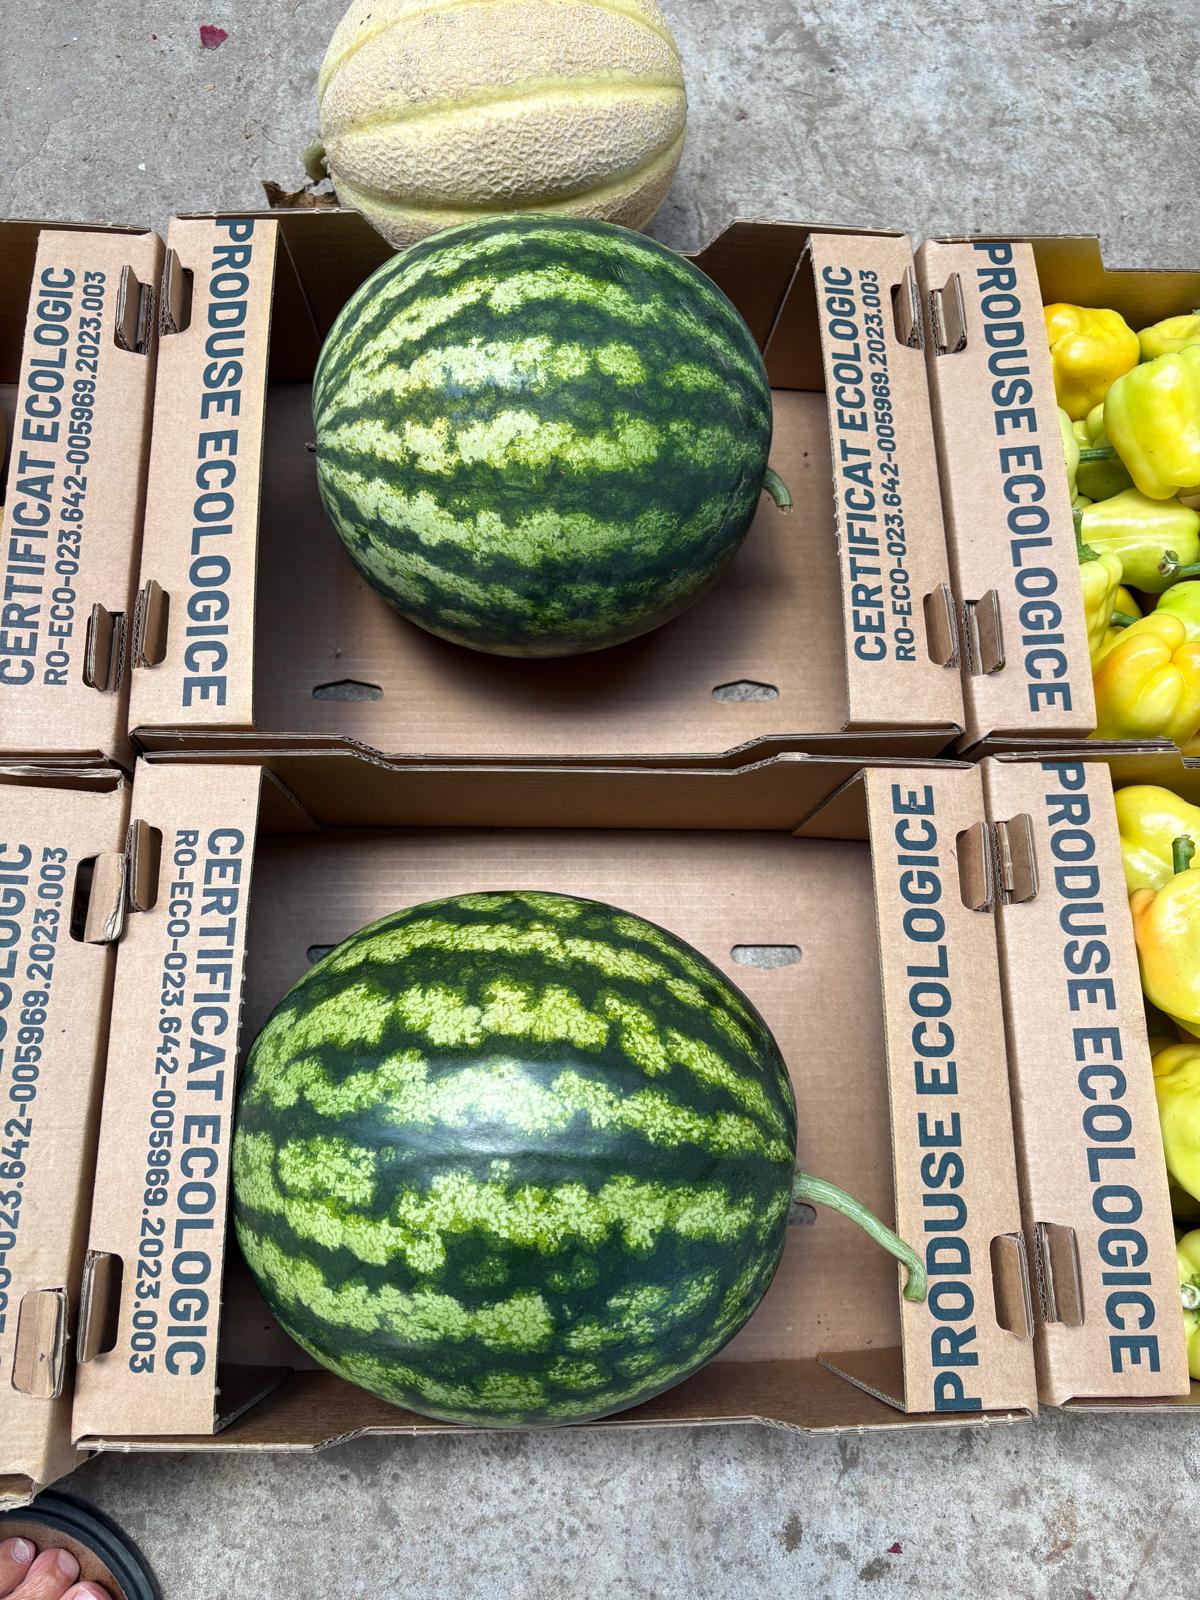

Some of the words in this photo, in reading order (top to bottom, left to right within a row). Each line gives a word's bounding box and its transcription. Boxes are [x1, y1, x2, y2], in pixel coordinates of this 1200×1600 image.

[22, 267, 76, 443] ECOLOGIC
[200, 218, 255, 420] PRODUSE
[822, 266, 868, 432] ECOLOGIC
[973, 242, 1037, 436] PRODUSE
[0, 450, 56, 686] CERTIFICAT
[43, 271, 106, 685] RO-ECO-023.642-005969.2023.003
[182, 429, 239, 707] ECOLOGICE
[840, 439, 887, 661] CERTIFICAT
[859, 270, 915, 661] RO-ECO-023.642-005969.2023.003
[1000, 445, 1072, 712] ECOLOGICE
[186, 828, 245, 1101] CERTIFICAT
[891, 783, 958, 1095] ECOLOGICE
[1041, 761, 1116, 1012] PRODUSE
[129, 830, 199, 1374] RO-ECO-023.642-005969.2023.003
[1072, 1026, 1161, 1373] ECOLOGICE
[165, 1115, 221, 1376] ECOLOGIC
[917, 1112, 983, 1413] PRODUSE
